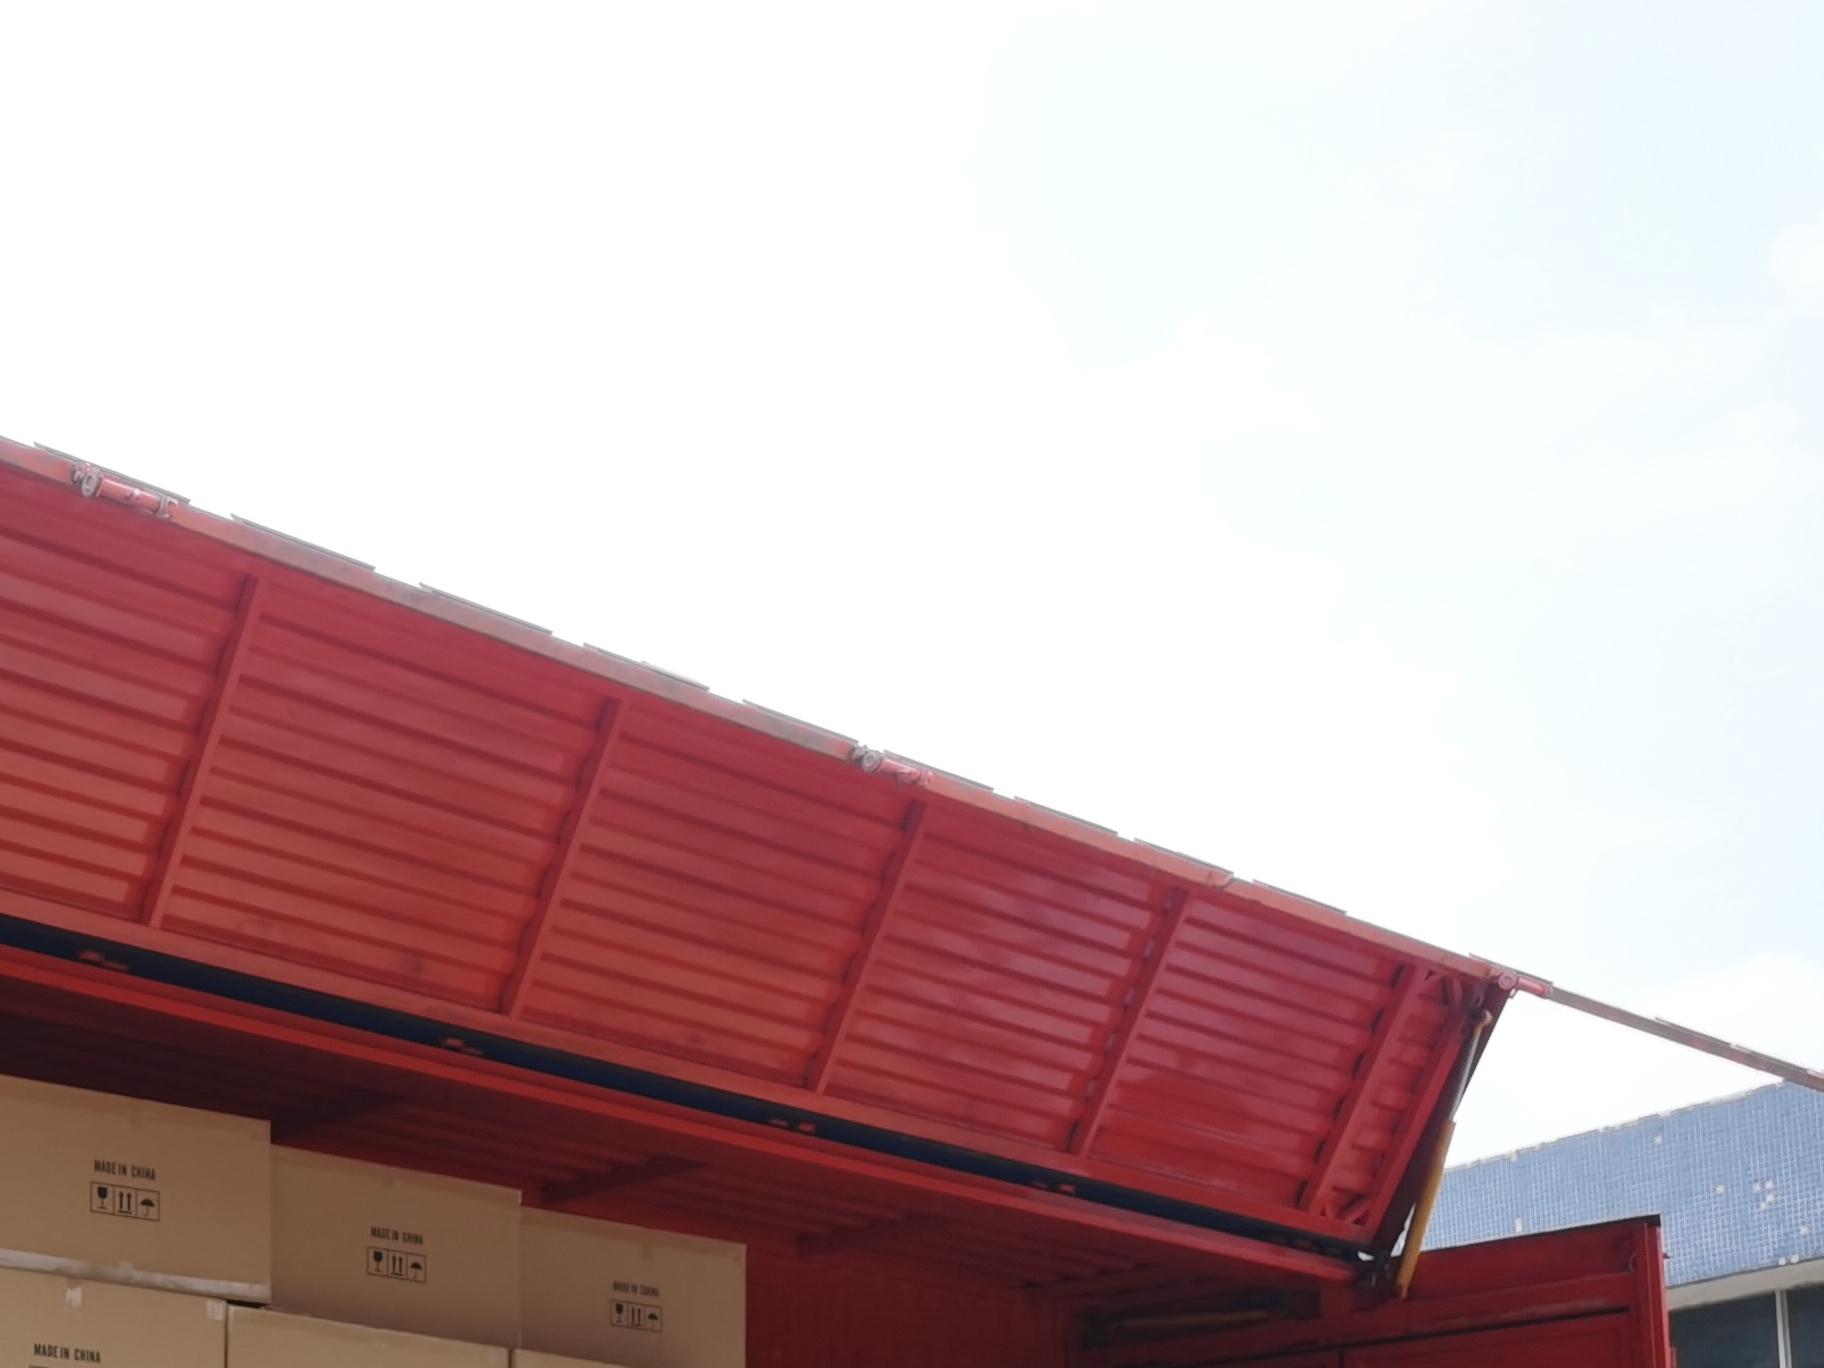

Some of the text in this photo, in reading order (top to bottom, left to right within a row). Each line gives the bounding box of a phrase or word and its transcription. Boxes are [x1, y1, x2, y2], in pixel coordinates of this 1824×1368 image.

[94, 1158, 156, 1181] MADE IN CHINA
[34, 1343, 101, 1363] MADE IN CHINA
